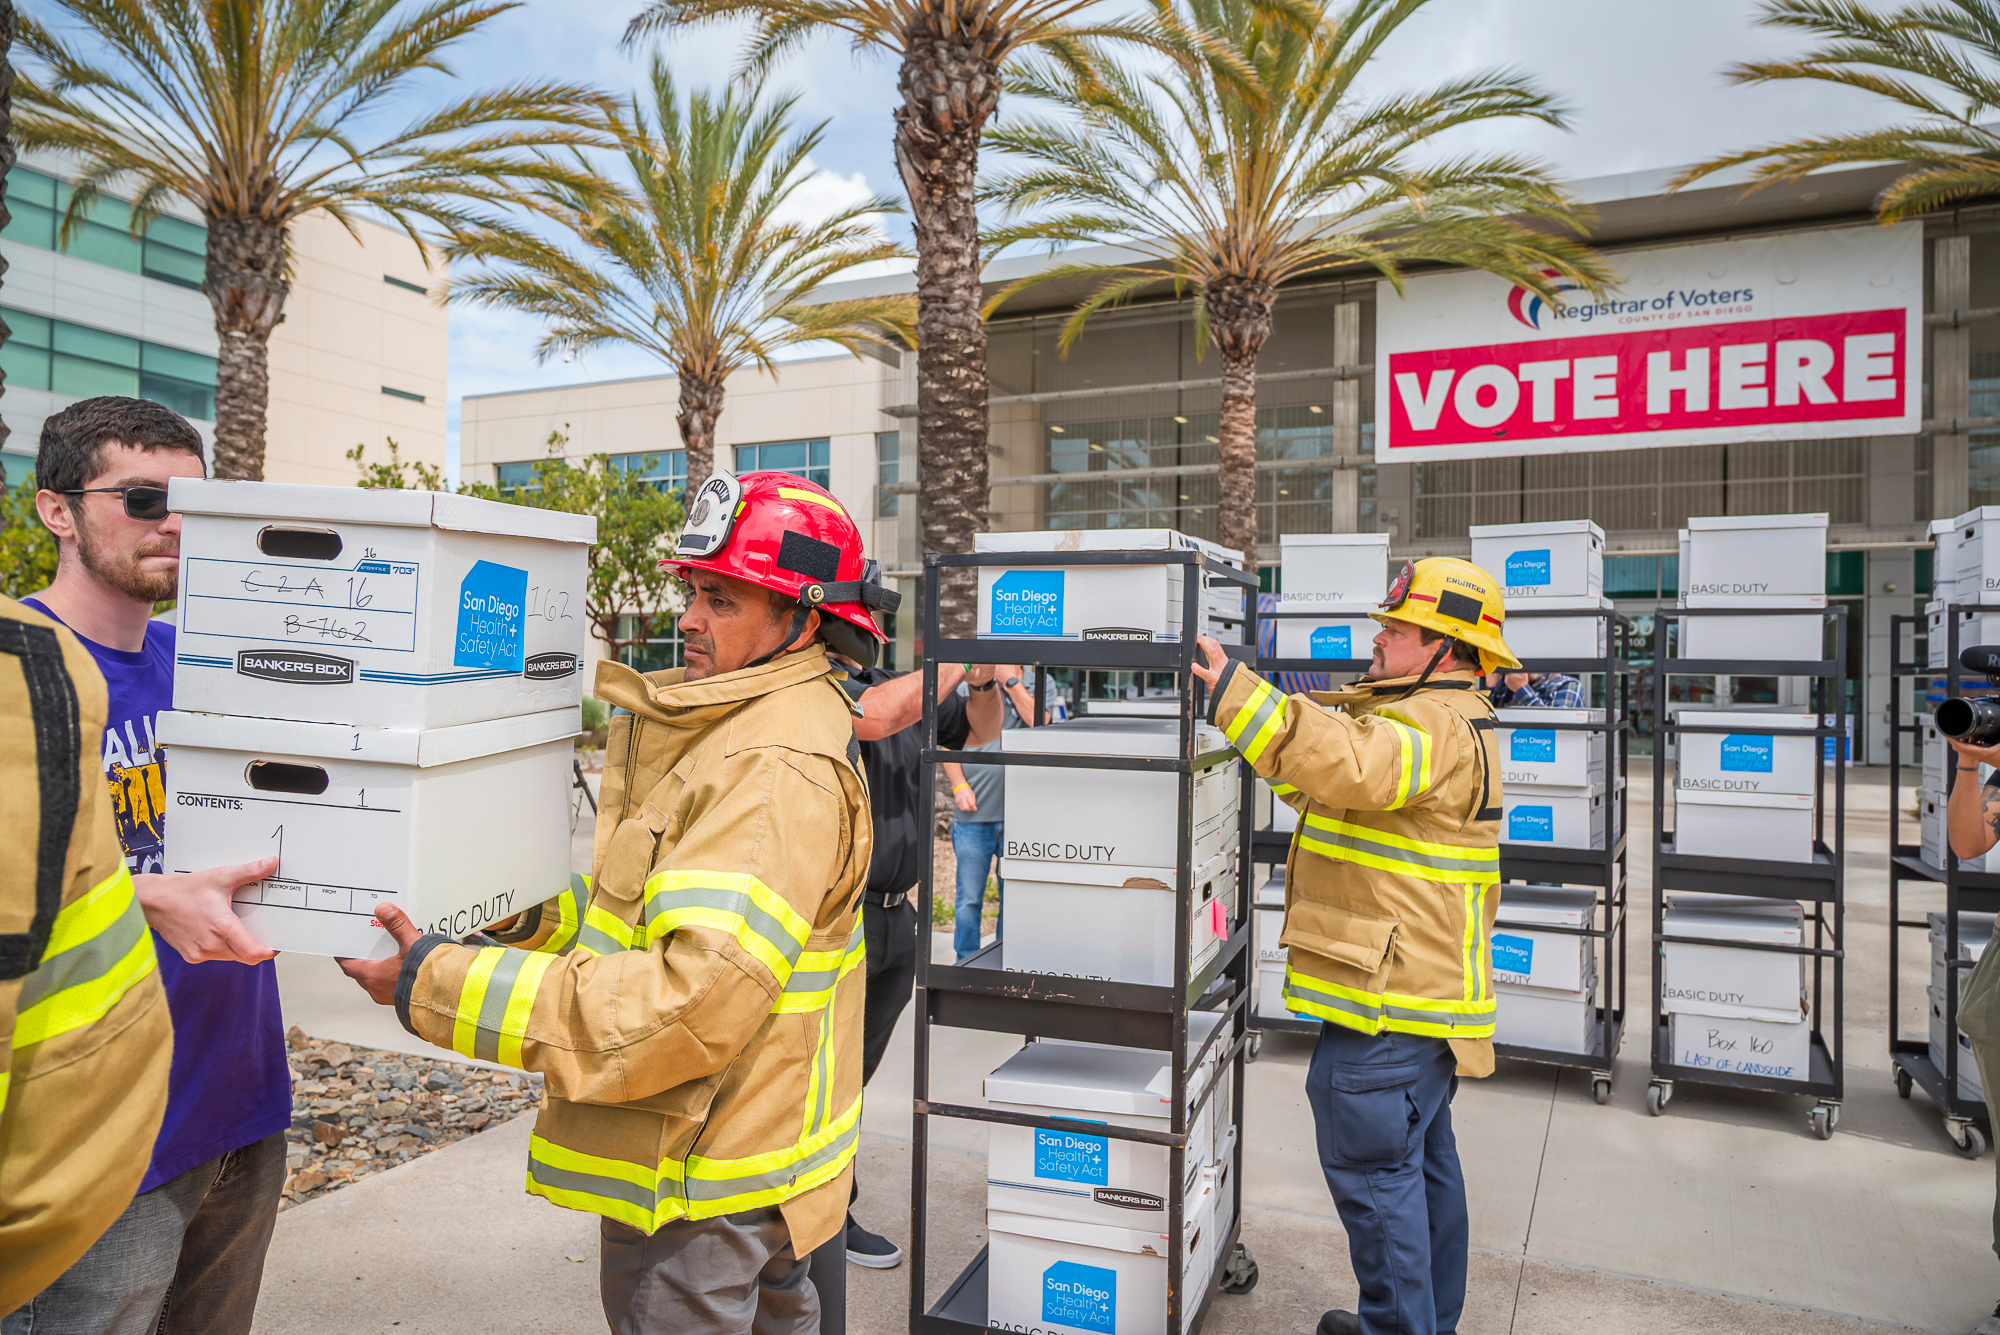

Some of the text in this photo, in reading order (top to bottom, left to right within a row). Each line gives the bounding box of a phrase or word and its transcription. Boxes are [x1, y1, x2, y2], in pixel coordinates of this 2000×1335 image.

[1553, 287, 1754, 322] Registrar of Voters
[1617, 304, 1753, 324] COUNTY OF SAN DIEGO
[1394, 332, 1897, 431] VOTE HERE
[364, 547, 377, 558] 16
[1507, 560, 1546, 570] San Diego
[347, 577, 373, 610] 16
[1446, 576, 1486, 595] ENGINEER
[1508, 586, 1539, 596] DUTY
[1692, 583, 1769, 594] BASIC DUTY
[463, 590, 520, 621] San Diego
[528, 586, 573, 622] 162
[995, 589, 1057, 605] San Diego
[1283, 592, 1344, 602] BASIC DUTY
[1004, 602, 1046, 615] Health
[470, 613, 508, 636] Health
[995, 613, 1058, 629] Safety Act
[1086, 633, 1149, 641] BANKERS BOX
[1326, 636, 1347, 645] Diego
[459, 632, 518, 660] Safety Act
[244, 657, 348, 676] BANKERS BOX
[527, 659, 574, 673] BANKERS BOX
[351, 732, 363, 751] 1
[1513, 736, 1552, 746] San Diego
[1723, 744, 1769, 755] San Diego
[1508, 772, 1539, 782] DUTY
[1683, 778, 1760, 790] BASIC DUTY
[176, 794, 243, 811] CONTENTS:
[357, 787, 369, 808] 1
[1510, 815, 1549, 825] San Diego
[1007, 841, 1116, 861] BASIC DUTY
[470, 888, 515, 929] DUTY
[1505, 945, 1528, 957] Diego
[1500, 973, 1531, 986] DUTY
[1668, 988, 1744, 1003] BASIC DUTY
[1706, 1028, 1774, 1054] Box 160
[1684, 1050, 1714, 1066] LAST
[1716, 1058, 1733, 1070] OF
[1038, 1133, 1101, 1154] San Diego
[1048, 1147, 1091, 1164] Health
[1038, 1158, 1103, 1178] Safety Act
[1097, 1192, 1160, 1207] BANKERS BOX
[1046, 1277, 1110, 1302] San Diego
[1056, 1292, 1098, 1311] Health
[1046, 1302, 1110, 1326] Safety Act
